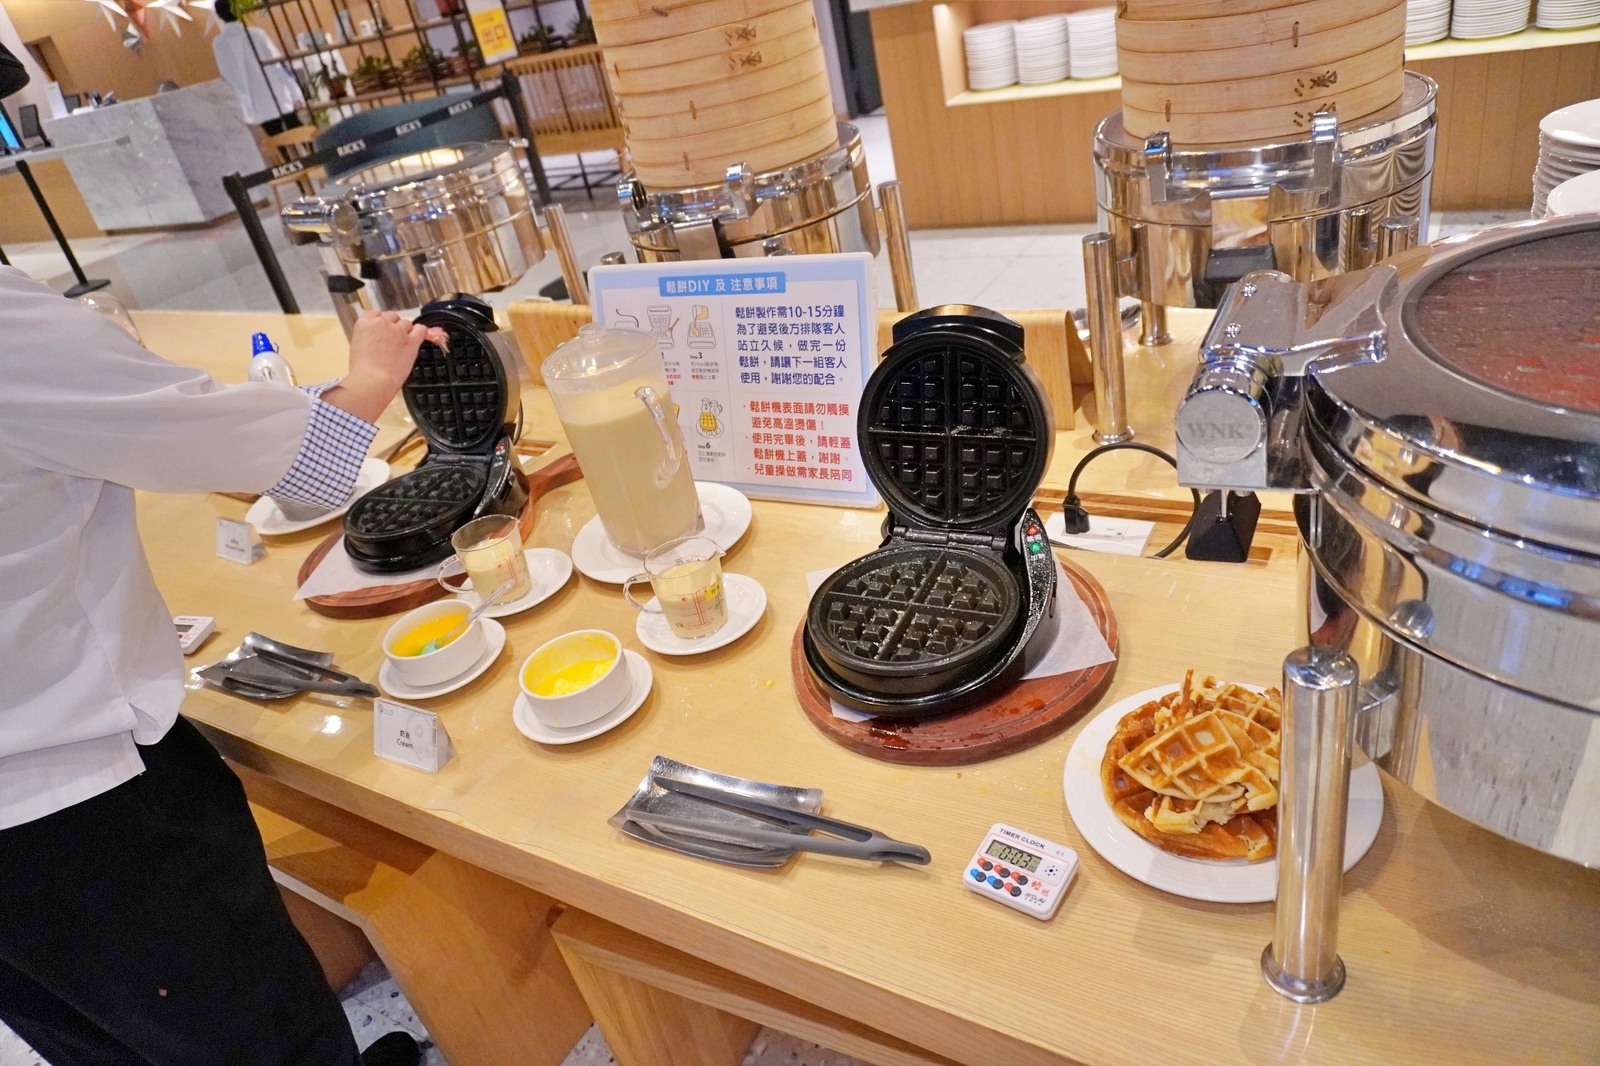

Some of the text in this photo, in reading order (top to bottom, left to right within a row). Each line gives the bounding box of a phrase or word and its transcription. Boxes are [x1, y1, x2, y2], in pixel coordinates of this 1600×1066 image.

[666, 276, 778, 294] 鬆餅DIY 及 注意事項
[735, 305, 845, 319] 鬆餅製作需10-15分鐘
[737, 322, 846, 336] 為了避免後方排隊客人
[737, 339, 846, 352] 站立久候，做完一份
[698, 351, 703, 359] 3
[739, 356, 847, 369] 鬆餅，請讓下一組客人
[740, 372, 844, 386] 使用，謝謝您的配合。
[750, 400, 850, 416] 鬆餅機表面請勿觸摸
[751, 416, 824, 432] 避免高溫燙傷！
[705, 441, 711, 449] 6
[752, 432, 851, 449] 使用完畢後，請輕蓋
[754, 447, 848, 465] 鬆餅機上蓋，謝謝。
[754, 463, 853, 482] 兒童操做需家長陪同
[396, 738, 414, 750] Cream
[1000, 828, 1046, 849] TIMER CLOCK
